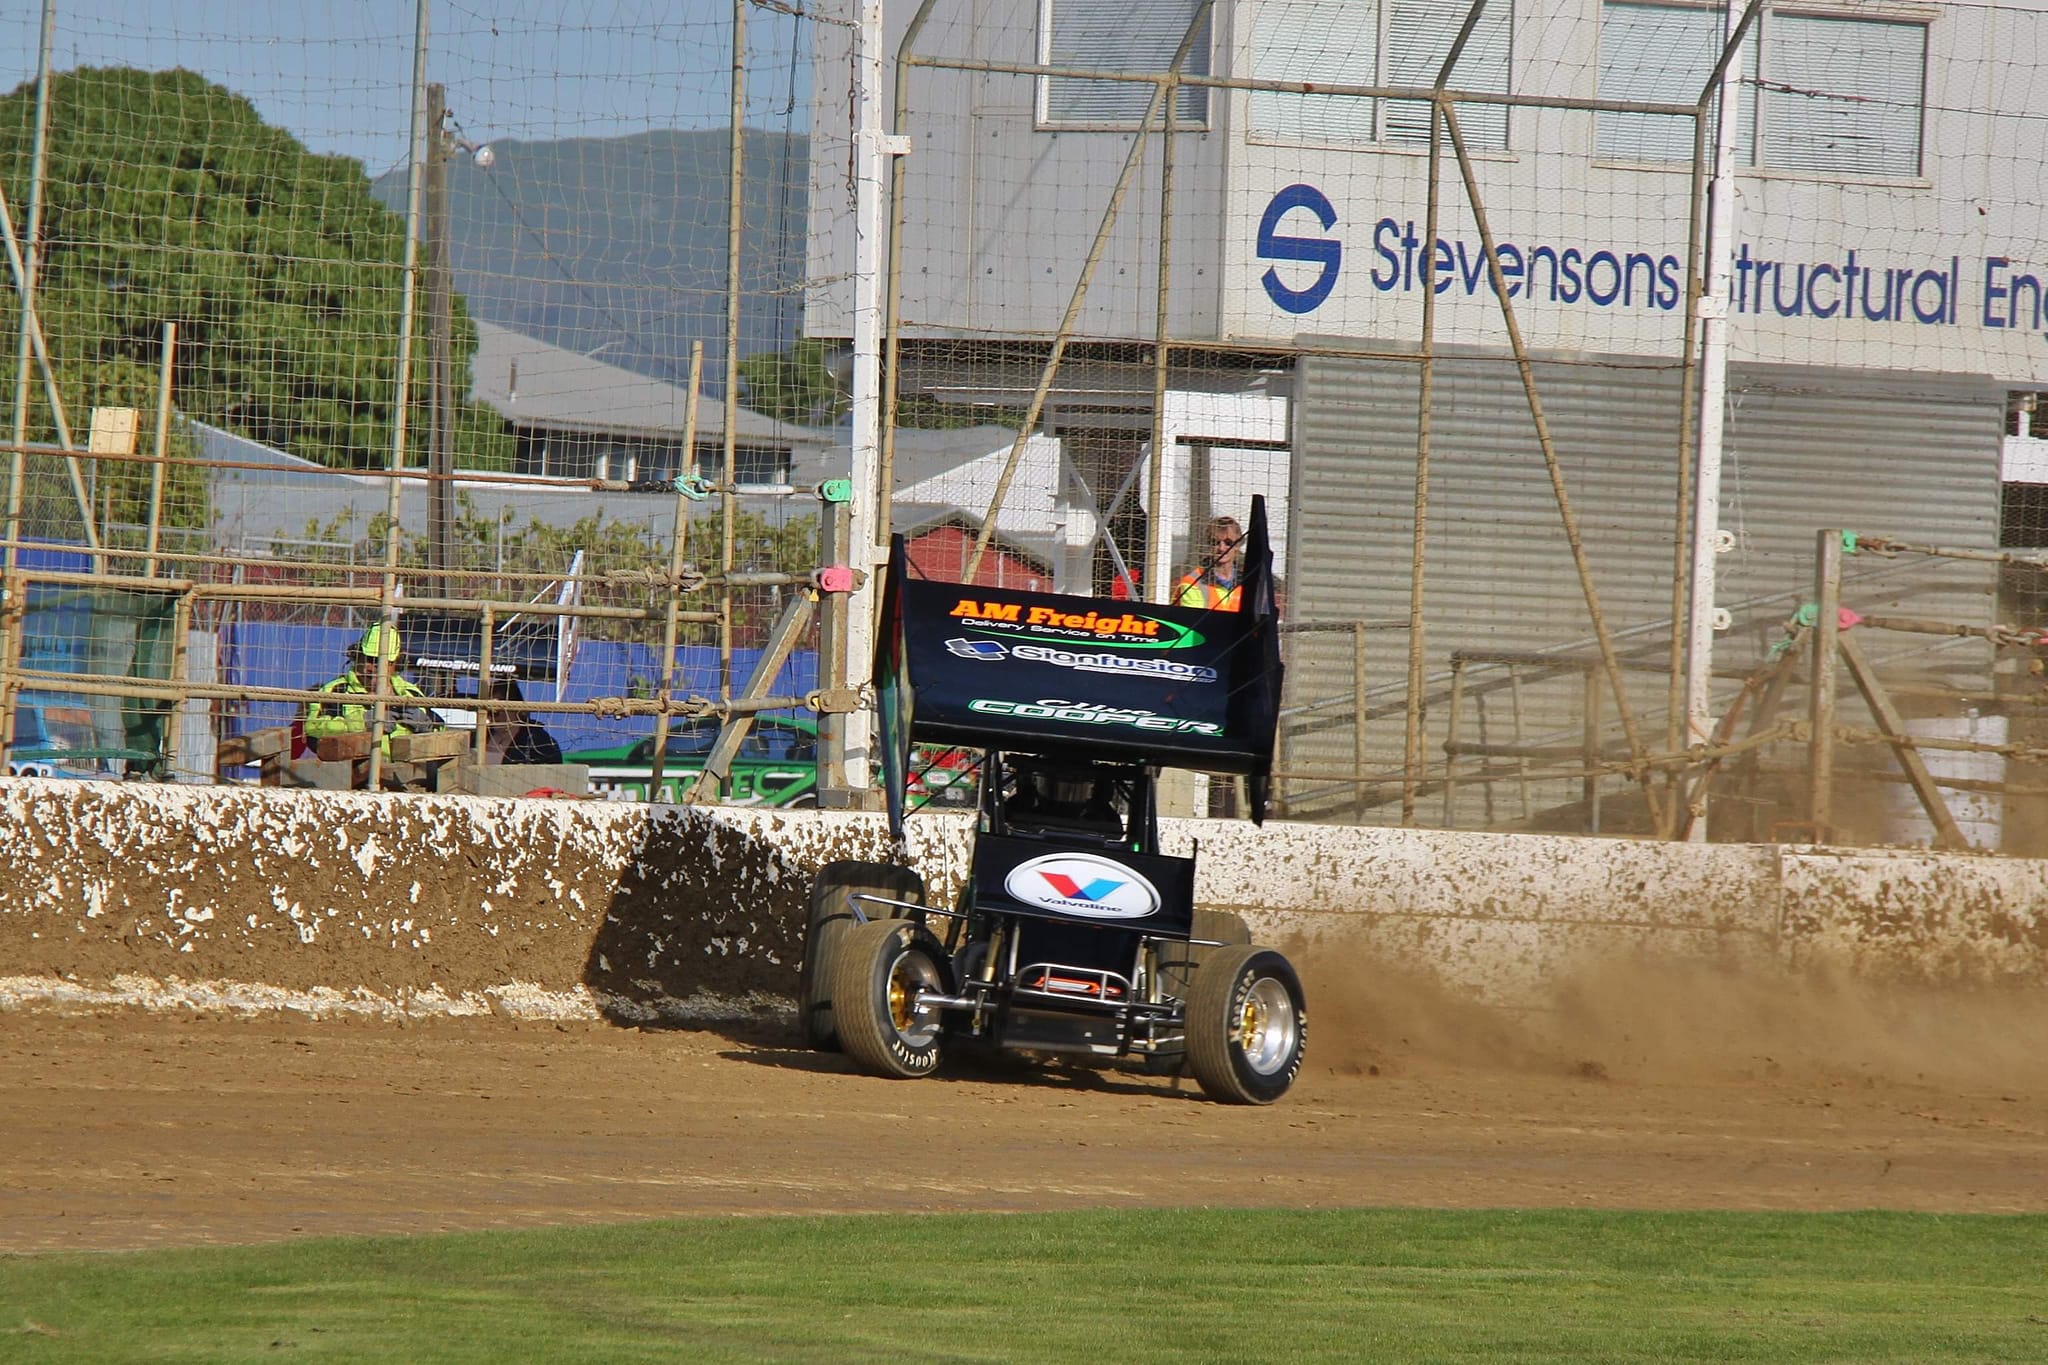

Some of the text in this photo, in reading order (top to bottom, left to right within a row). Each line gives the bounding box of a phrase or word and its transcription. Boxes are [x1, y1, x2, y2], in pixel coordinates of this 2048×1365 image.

[1370, 217, 2048, 342] Stevensons tructural En
[949, 600, 1160, 636] AM Freight
[961, 618, 1160, 644] Delivery Service on Time
[1011, 645, 1218, 680] Signfusion
[969, 699, 1223, 737] COOPER
[1037, 896, 1123, 912] Valvoline
